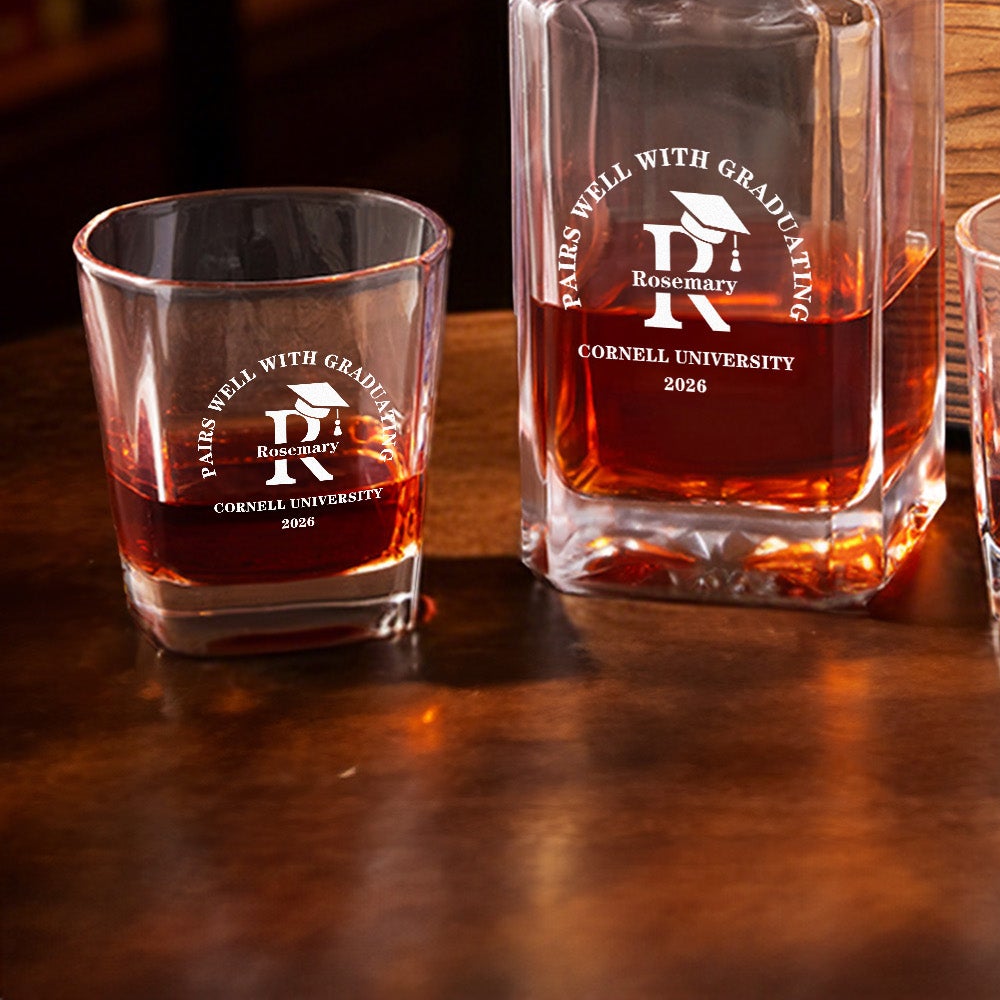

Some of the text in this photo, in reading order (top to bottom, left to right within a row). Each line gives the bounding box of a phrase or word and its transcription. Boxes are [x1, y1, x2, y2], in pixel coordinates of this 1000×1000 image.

[559, 147, 812, 322] PAIRS WELL WITH GRADUATING
[631, 270, 738, 295] Rosemary
[577, 344, 795, 371] CORNELL UNIVERSITY
[664, 377, 707, 393] 2026
[198, 351, 399, 479] PAIRS WELL WITH GRADUATING
[257, 441, 340, 459] Rosemary
[213, 487, 384, 514] CORNELL UNIVERSITY
[281, 516, 315, 529] 2026
